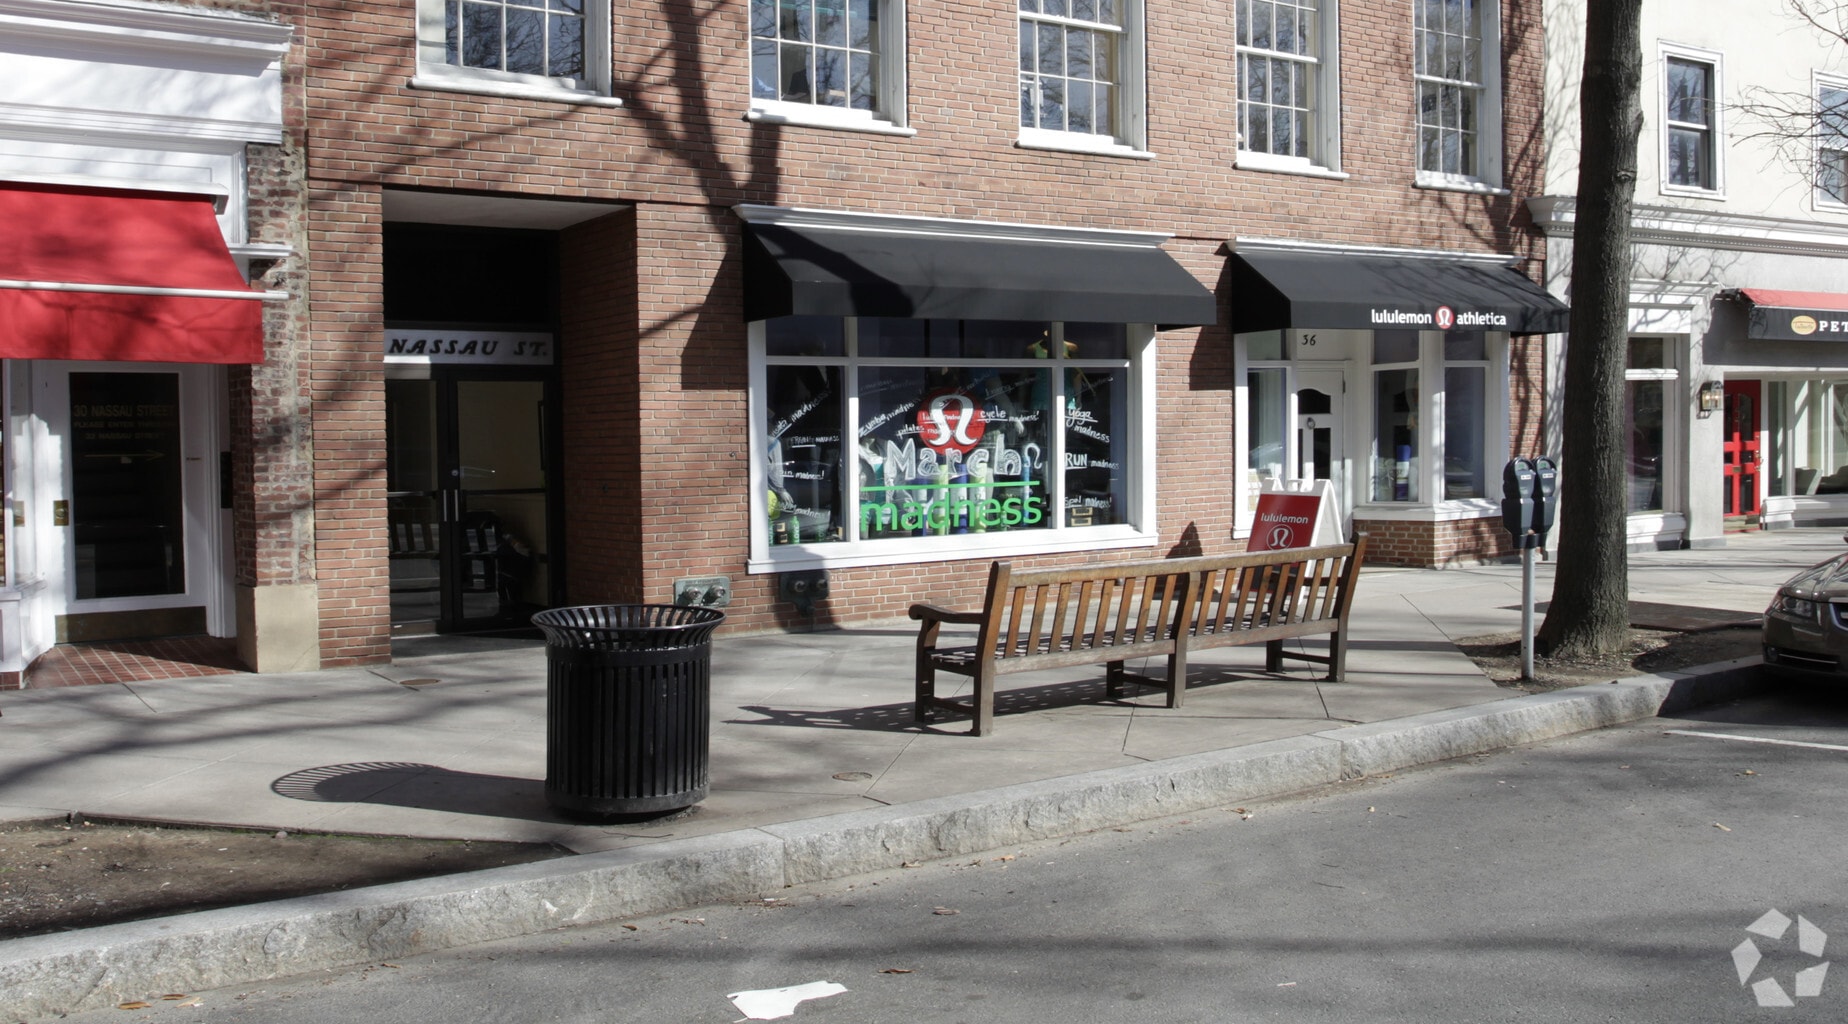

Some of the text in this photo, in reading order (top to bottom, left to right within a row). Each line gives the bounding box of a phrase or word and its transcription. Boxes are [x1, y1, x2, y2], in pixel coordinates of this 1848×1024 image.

[1371, 309, 1507, 325] lululemon athletica
[389, 338, 548, 357] NASSAU ST.
[1301, 334, 1317, 346] 36
[73, 404, 176, 417] 30 NASSAU STREET
[1074, 425, 1110, 443] madness
[886, 433, 1022, 480] March
[1065, 452, 1088, 467] RUN
[860, 492, 1042, 532] madness
[1261, 512, 1309, 524] lululemon
